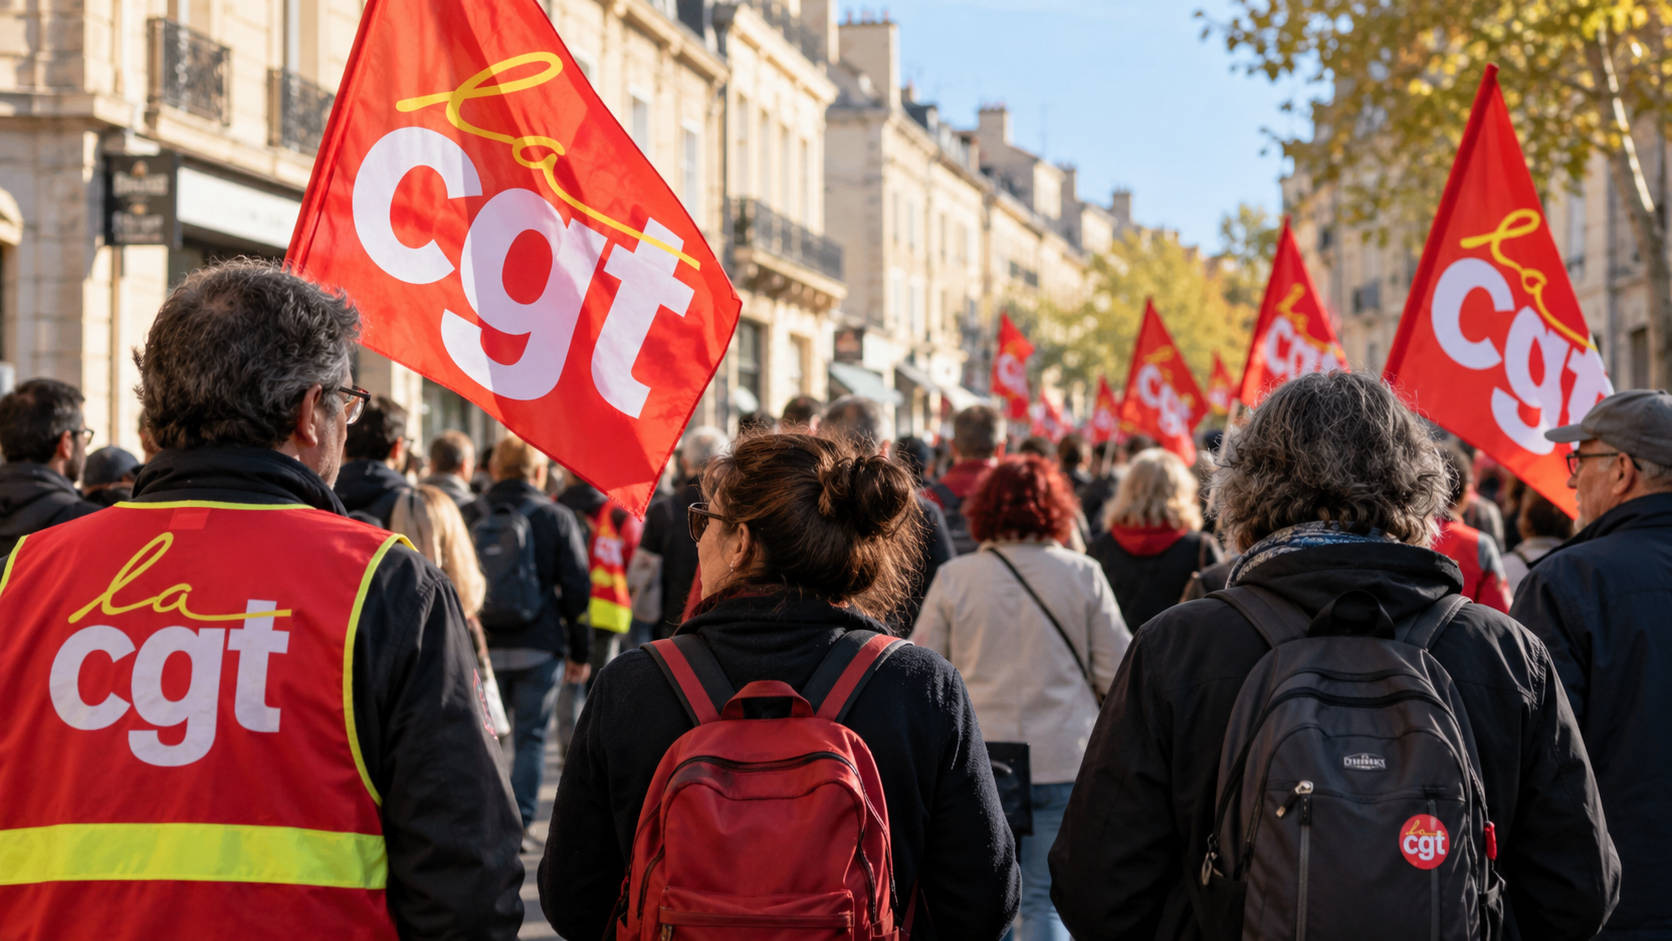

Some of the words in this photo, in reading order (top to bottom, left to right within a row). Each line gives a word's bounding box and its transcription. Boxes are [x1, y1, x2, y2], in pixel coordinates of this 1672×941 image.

[396, 52, 700, 271] la
[352, 126, 695, 419] cgt
[1460, 208, 1598, 351] la
[69, 532, 292, 624] la
[49, 599, 290, 767] cgt
[1403, 831, 1446, 861] cgt
[1405, 819, 1445, 836] la
